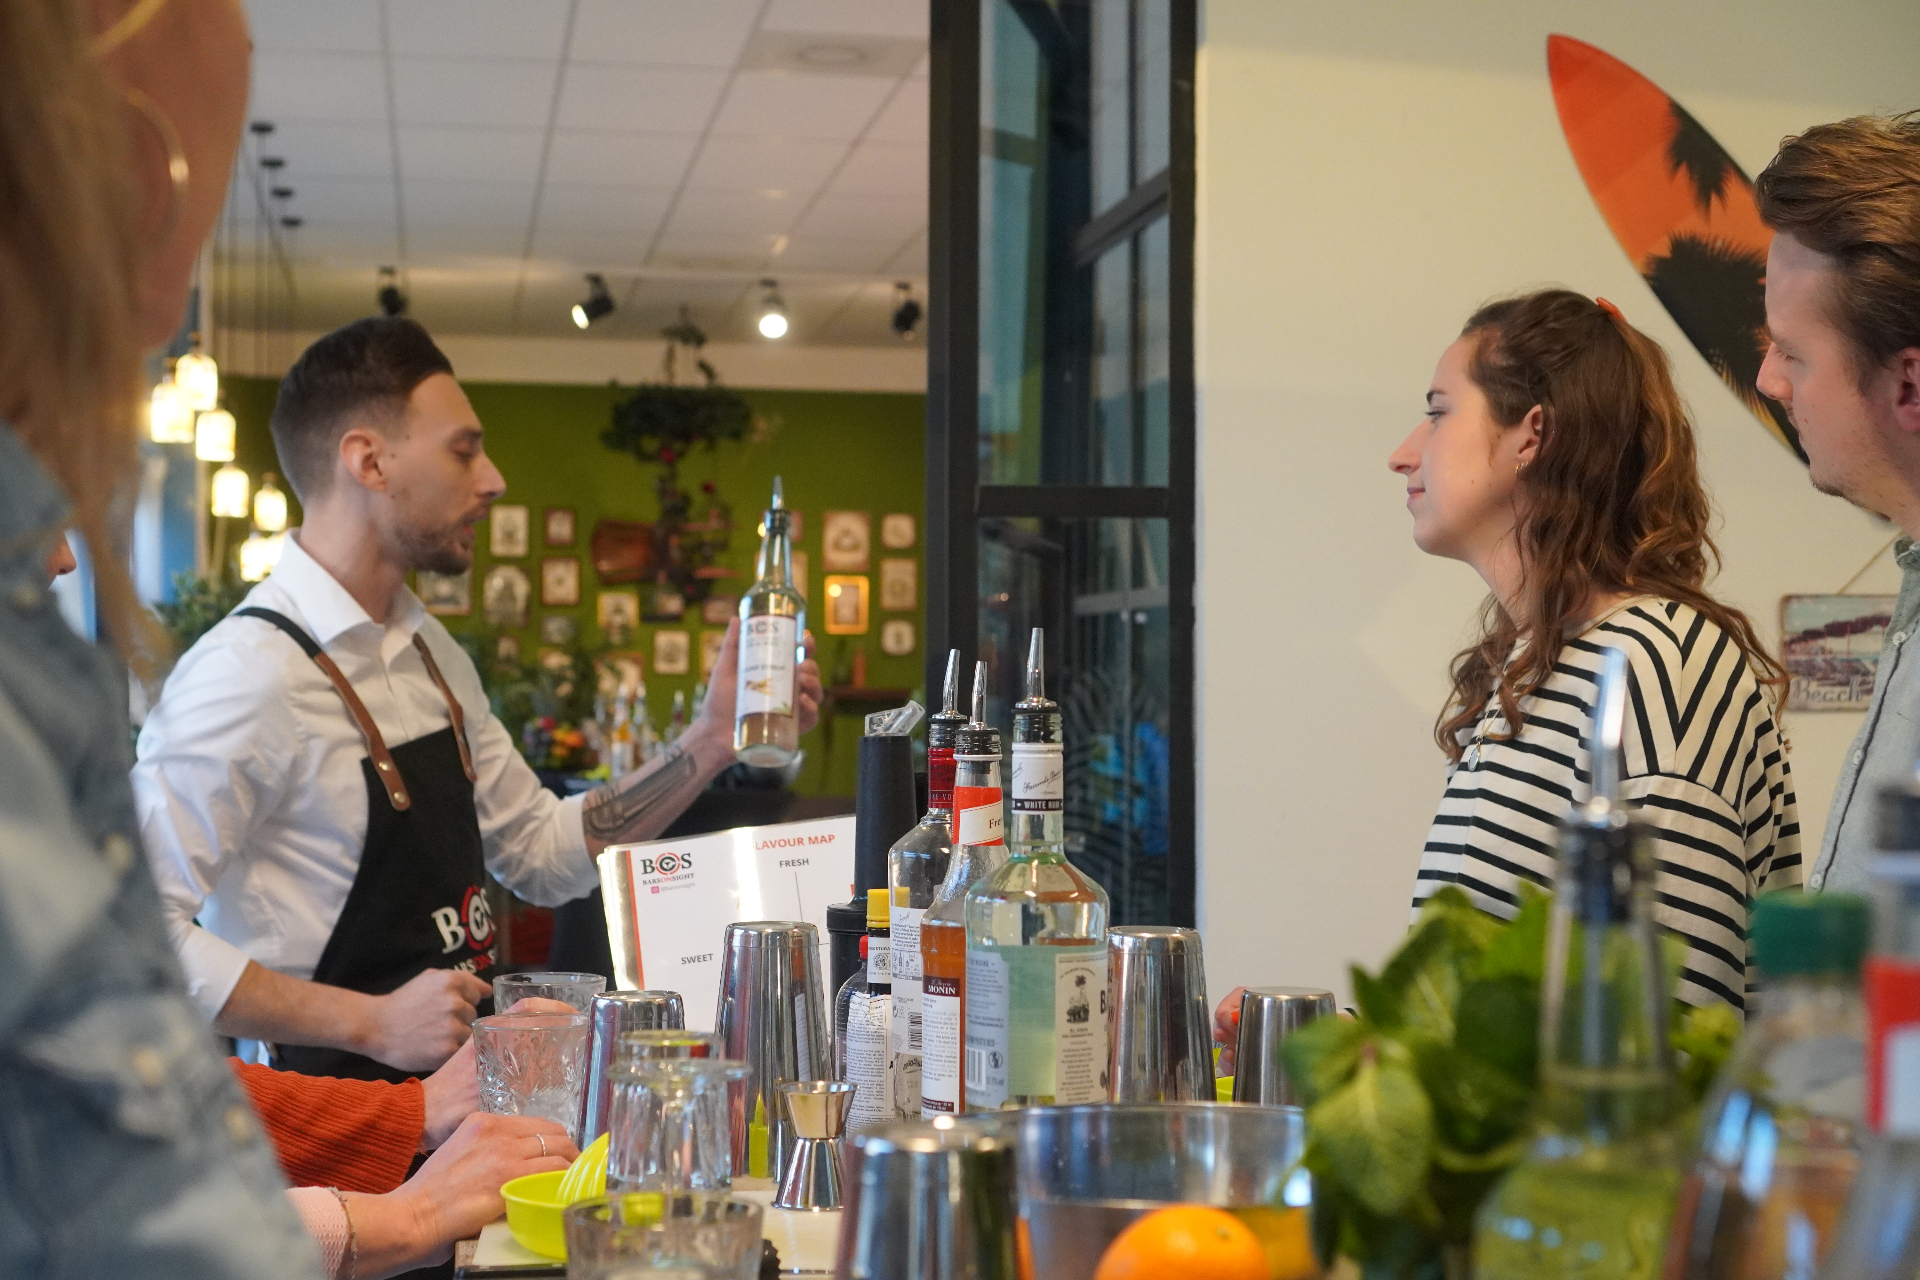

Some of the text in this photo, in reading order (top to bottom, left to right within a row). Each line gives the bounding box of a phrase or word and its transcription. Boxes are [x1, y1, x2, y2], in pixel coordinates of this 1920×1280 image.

[1790, 676, 1863, 701] Beach
[1024, 800, 1047, 810] WHITE
[1048, 800, 1060, 809] RUM
[755, 834, 836, 850] LAVOUR MAP
[640, 852, 692, 876] BOS
[779, 858, 810, 868] FRESH
[642, 872, 695, 886] BARSONSIGHT
[681, 953, 714, 965] SWEET
[928, 984, 956, 995] MONIN
